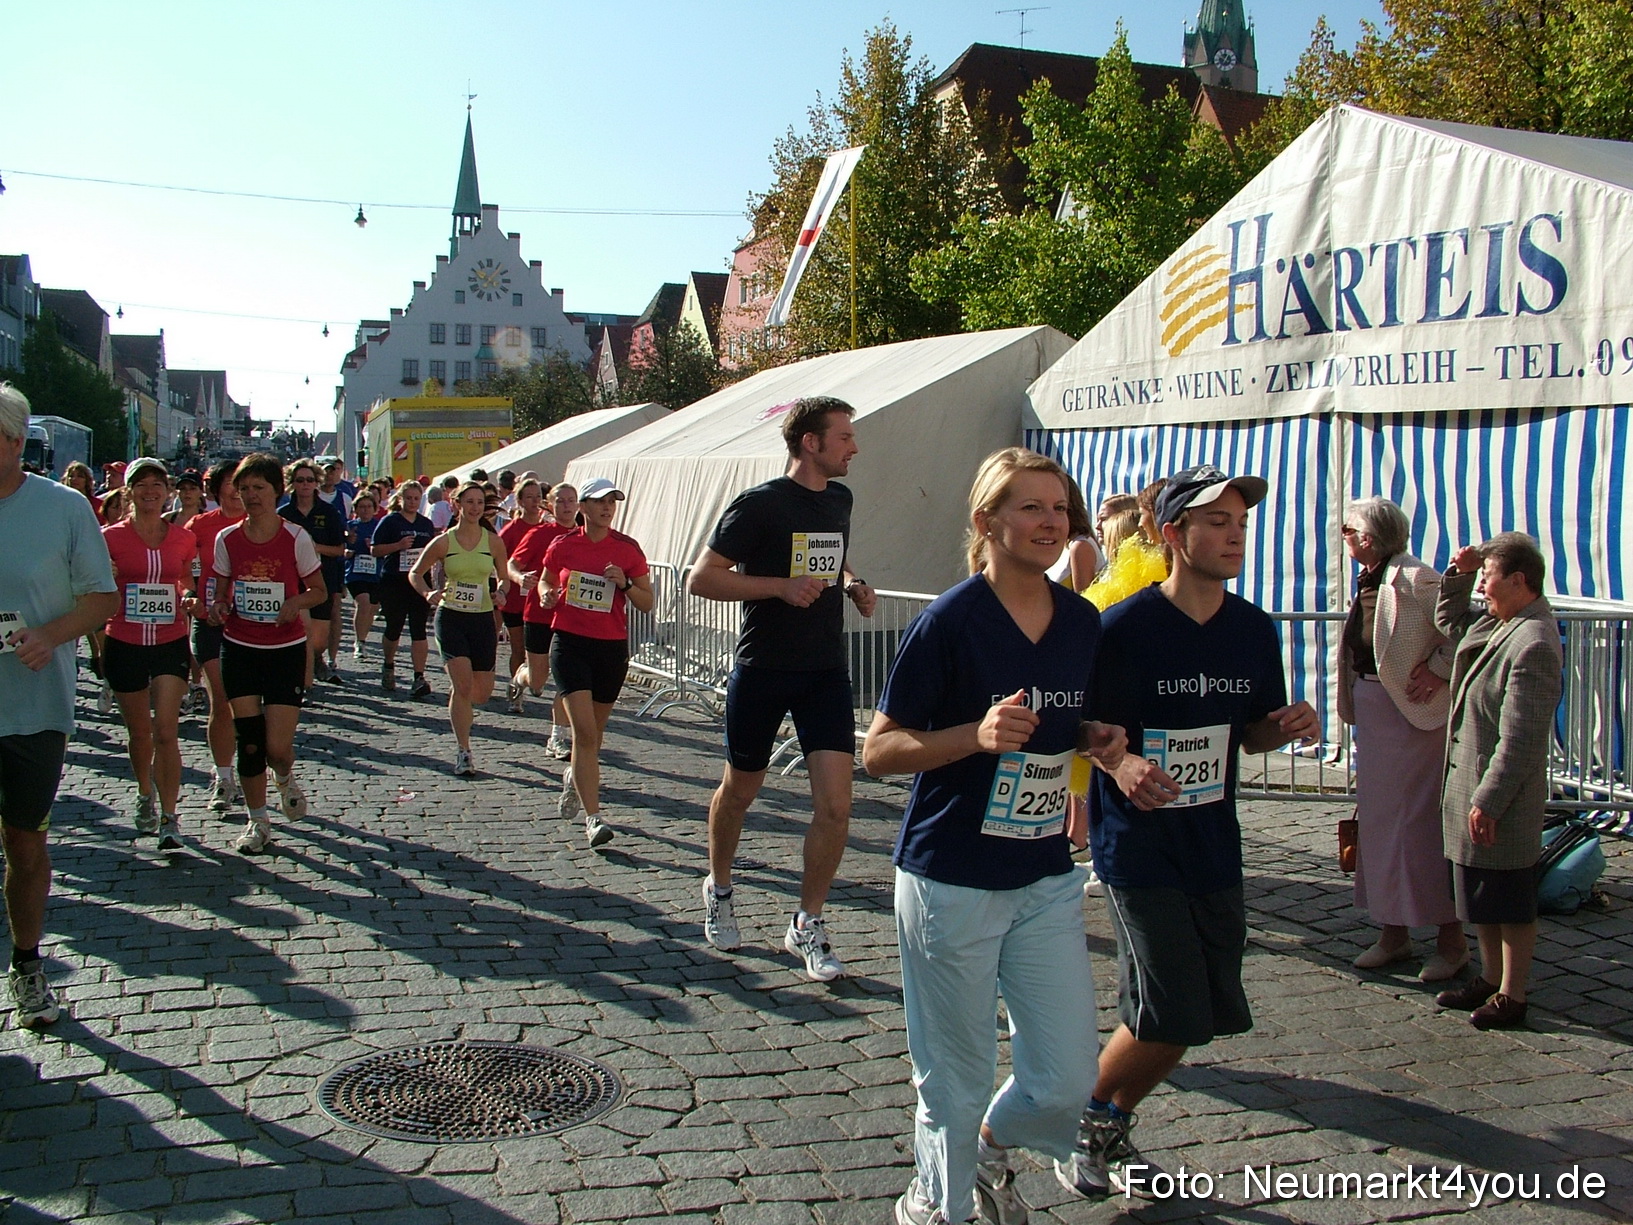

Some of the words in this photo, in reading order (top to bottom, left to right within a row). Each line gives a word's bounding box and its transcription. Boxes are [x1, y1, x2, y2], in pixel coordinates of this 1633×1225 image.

[1222, 211, 1568, 346] HÄRTEIS
[1062, 376, 1164, 413] GETRÄNKE
[1176, 368, 1243, 401] WEINE
[1494, 342, 1585, 380] TEL.
[795, 553, 803, 562] D
[808, 556, 835, 572] 932
[580, 576, 606, 588] Daniela
[139, 588, 169, 596] Manuela
[246, 587, 272, 595] Christa
[455, 591, 475, 601] 236
[579, 588, 603, 601] 716
[139, 601, 173, 613] 2846
[247, 600, 281, 612] 2630
[1167, 736, 1210, 753] Patrick
[1169, 758, 1219, 785] 2281
[998, 782, 1010, 795] D
[1016, 786, 1067, 816] 2295
